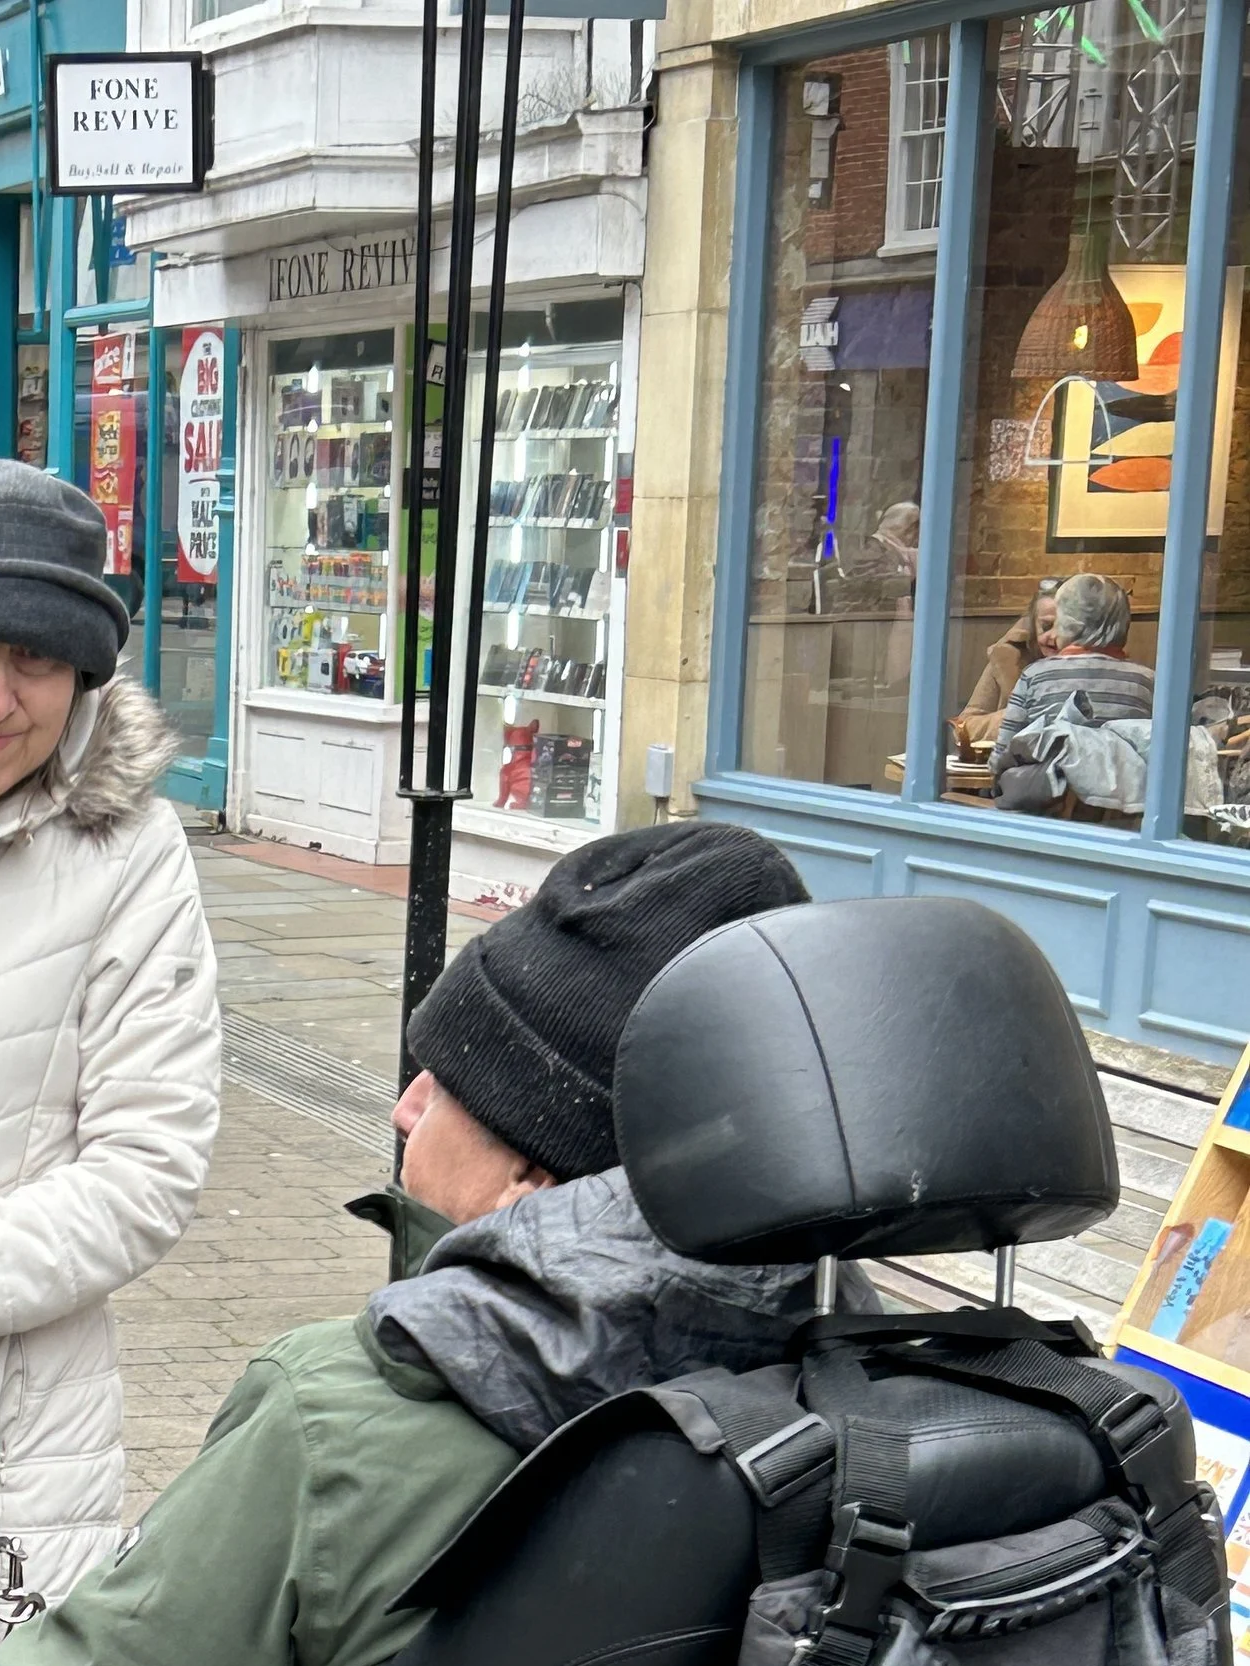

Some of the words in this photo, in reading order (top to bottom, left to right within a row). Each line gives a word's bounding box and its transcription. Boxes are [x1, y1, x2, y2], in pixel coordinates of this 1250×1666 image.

[90, 76, 159, 102] FONE
[72, 108, 179, 132] REVIVE
[276, 250, 330, 301] FONE
[340, 236, 416, 293] REVIV
[197, 357, 218, 395] BIG
